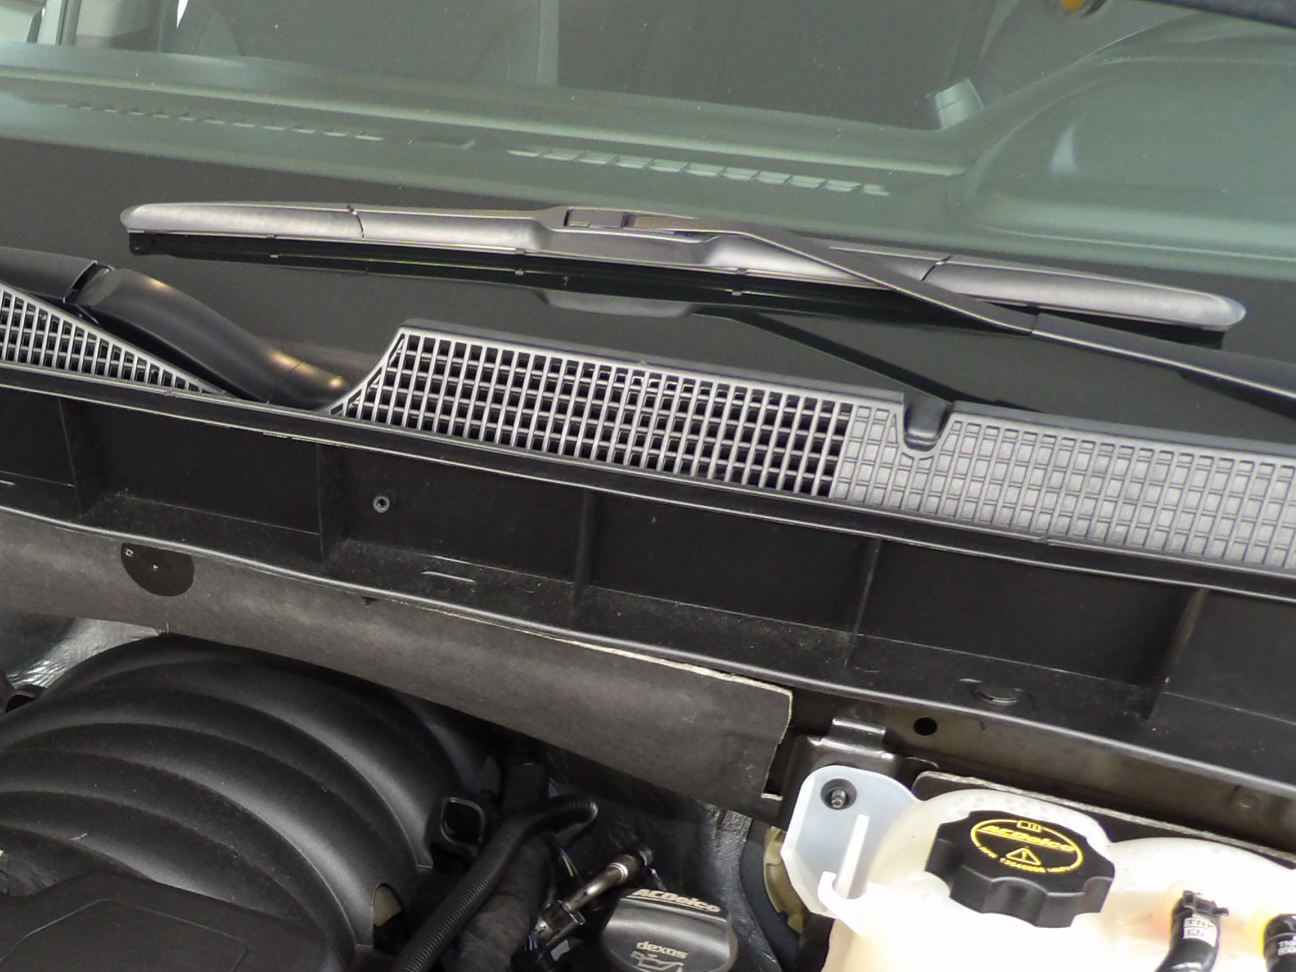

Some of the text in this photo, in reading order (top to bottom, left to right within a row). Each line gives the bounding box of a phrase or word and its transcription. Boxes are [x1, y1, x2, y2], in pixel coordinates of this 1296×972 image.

[978, 825, 1076, 853] ACDelco
[630, 888, 721, 913] ACDelco
[635, 941, 688, 959] dexos
